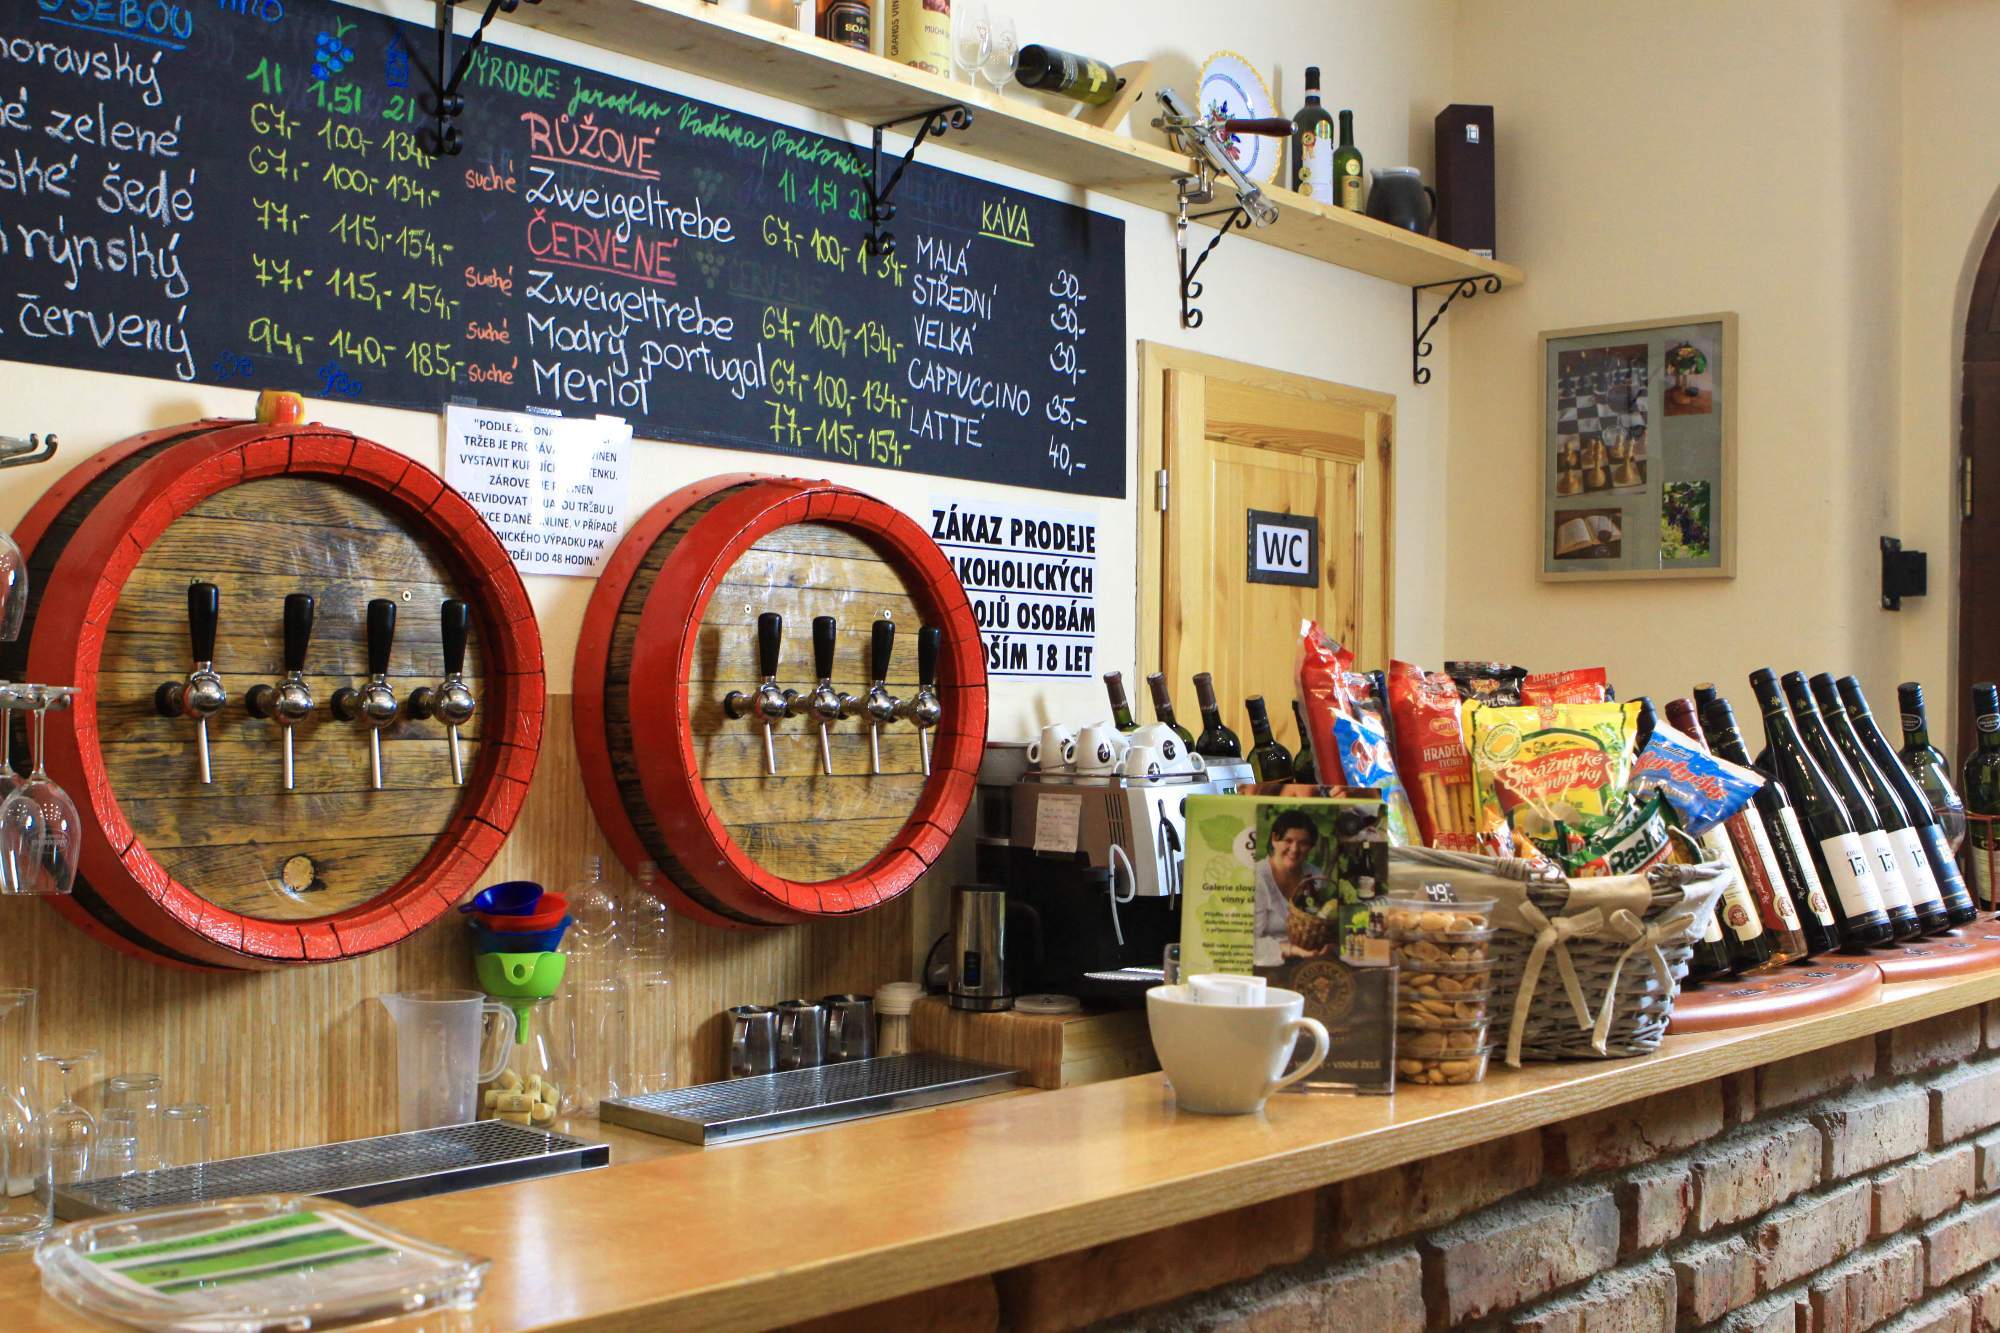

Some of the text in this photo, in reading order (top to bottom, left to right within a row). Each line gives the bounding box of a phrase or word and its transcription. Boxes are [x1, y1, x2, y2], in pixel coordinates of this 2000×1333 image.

[44, 102, 183, 157] zelené
[322, 162, 380, 197] 100,-
[385, 174, 441, 208] 134,-
[317, 118, 374, 158] 100,-
[382, 130, 438, 170] 134,-
[520, 112, 661, 176] RŮŽOVÉ
[330, 213, 393, 252] 115,-
[396, 226, 454, 268] 154,-
[526, 166, 736, 243] Zweigeltrebe
[810, 227, 850, 273] 100,-
[527, 207, 677, 279] ČERVENÉ
[982, 196, 1031, 241] KÁVA
[17, 215, 190, 299] rýnský
[326, 268, 392, 311] 115,-
[402, 283, 460, 321] 154,-
[916, 234, 1087, 307] MALÁ 30,-
[526, 270, 734, 341] Zweigeltrebe
[809, 313, 851, 358] 100,-
[854, 320, 904, 364] 134,-
[912, 274, 1086, 341] STŘEDNÍ 30,-
[249, 317, 314, 365] 94,-
[329, 329, 397, 368] 140,-
[405, 341, 465, 383] 185,-
[527, 312, 629, 377] Modrý
[814, 370, 857, 417] 100,-
[862, 380, 909, 419] 134,-
[914, 313, 1087, 385] VELKÁ 30,-
[532, 358, 649, 415] Merlot
[816, 418, 870, 461] 115,-
[868, 428, 912, 467] 154,-
[908, 358, 1088, 431] CAPPUCCINO 35,-
[459, 453, 510, 469] VYSTAVIT
[463, 434, 496, 449] TRŽEB
[498, 439, 509, 450] JE
[1048, 434, 1087, 477] 40,-
[489, 473, 531, 489] ZÁROVE
[496, 530, 605, 549] NICKÉHO VÝPADKU PAK
[932, 504, 1096, 553] ZÁKAZ PRODEJE
[1263, 531, 1302, 567] WC
[535, 551, 550, 562] DO
[551, 553, 563, 564] 48
[950, 556, 1093, 594] KOHOLICKÝCH
[974, 595, 1096, 633] OJŮ OSOBÁM
[1037, 644, 1058, 672] 18
[1065, 645, 1093, 671] LET
